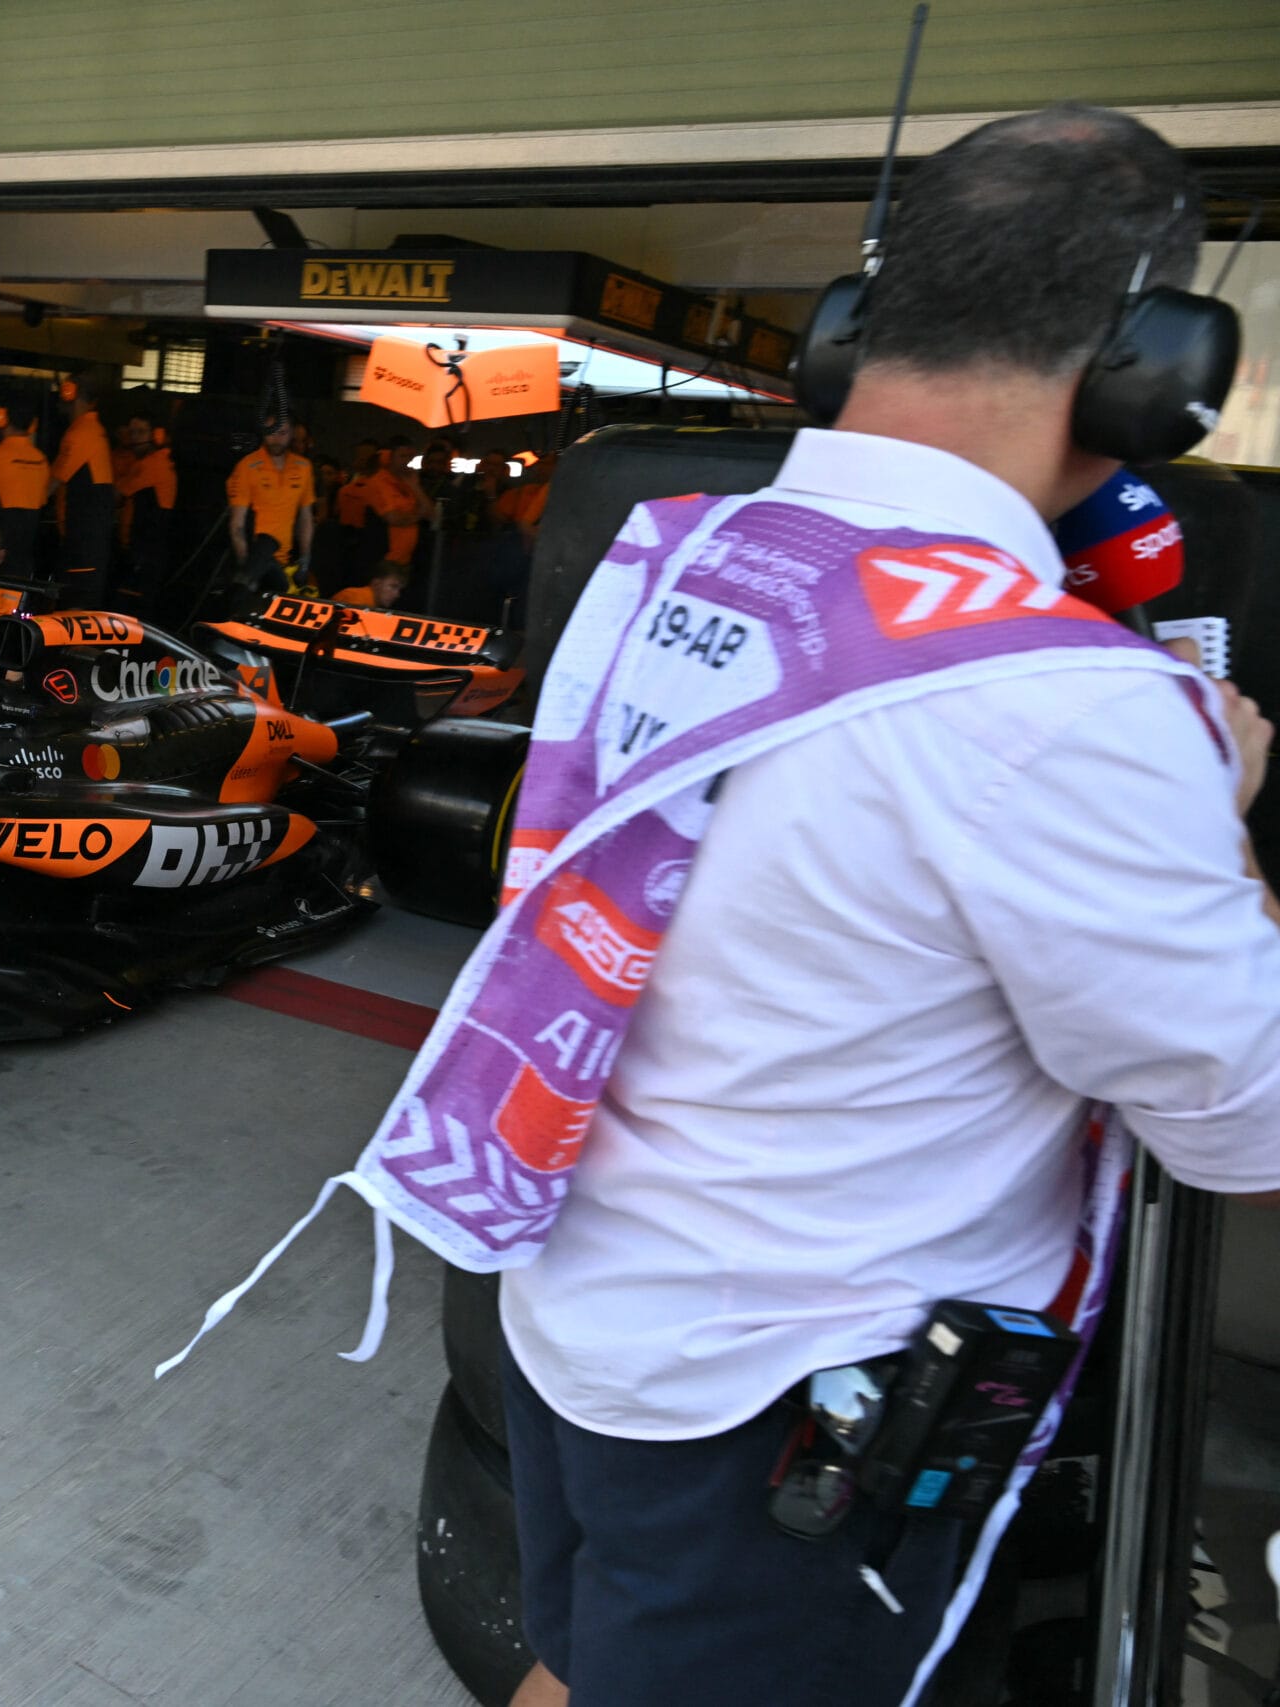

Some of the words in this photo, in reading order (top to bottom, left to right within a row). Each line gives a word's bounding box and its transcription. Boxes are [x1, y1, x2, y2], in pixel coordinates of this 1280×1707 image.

[52, 615, 129, 641] VELO
[91, 648, 220, 702] Chrome
[267, 720, 295, 741] DELL
